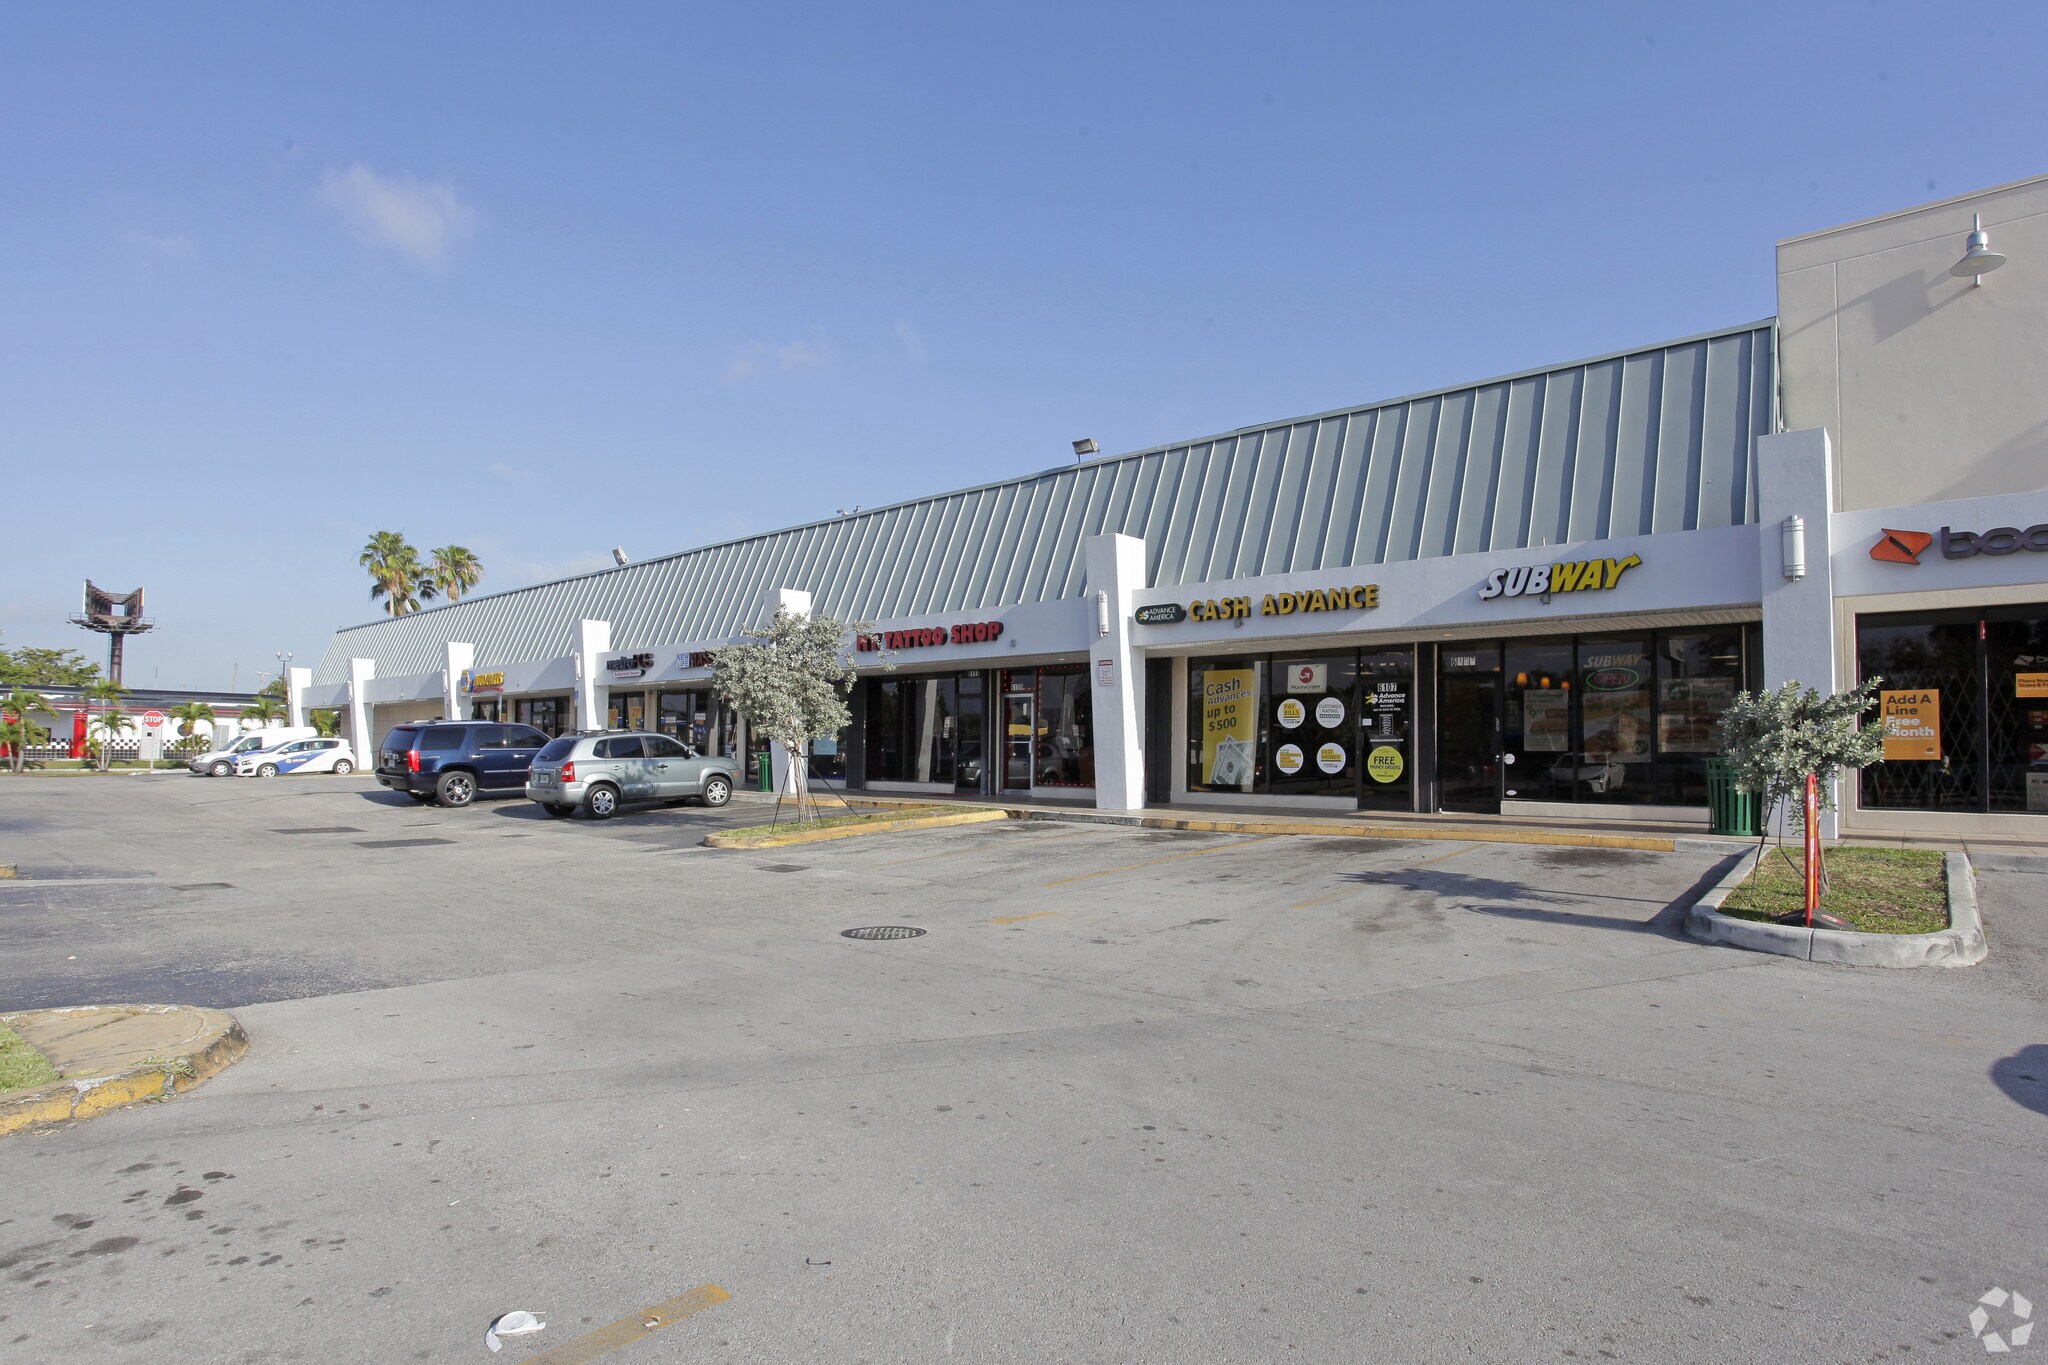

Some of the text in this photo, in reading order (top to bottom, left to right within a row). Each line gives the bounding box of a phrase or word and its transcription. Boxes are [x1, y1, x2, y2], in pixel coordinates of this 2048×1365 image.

[1477, 553, 1643, 600] SUBWAY
[1188, 583, 1380, 621] CASH ADVANCE
[1149, 612, 1174, 621] AMERICA
[884, 626, 948, 650] TATTOO
[951, 621, 1004, 645] SHOP
[677, 652, 689, 660] NEW
[1584, 653, 1644, 668] SUBWAY
[677, 660, 689, 668] LIFE
[1592, 672, 1631, 685] OPEN
[1206, 677, 1241, 696] Cash
[1378, 682, 1397, 692] 6107
[1207, 689, 1252, 706] Advances
[1887, 694, 1932, 704] Add A
[1207, 704, 1236, 720] up to
[1886, 705, 1918, 715] Line
[144, 715, 163, 723] STOP
[1208, 716, 1237, 732] $500
[1886, 715, 1920, 726] Free
[1373, 755, 1396, 765] FREE
